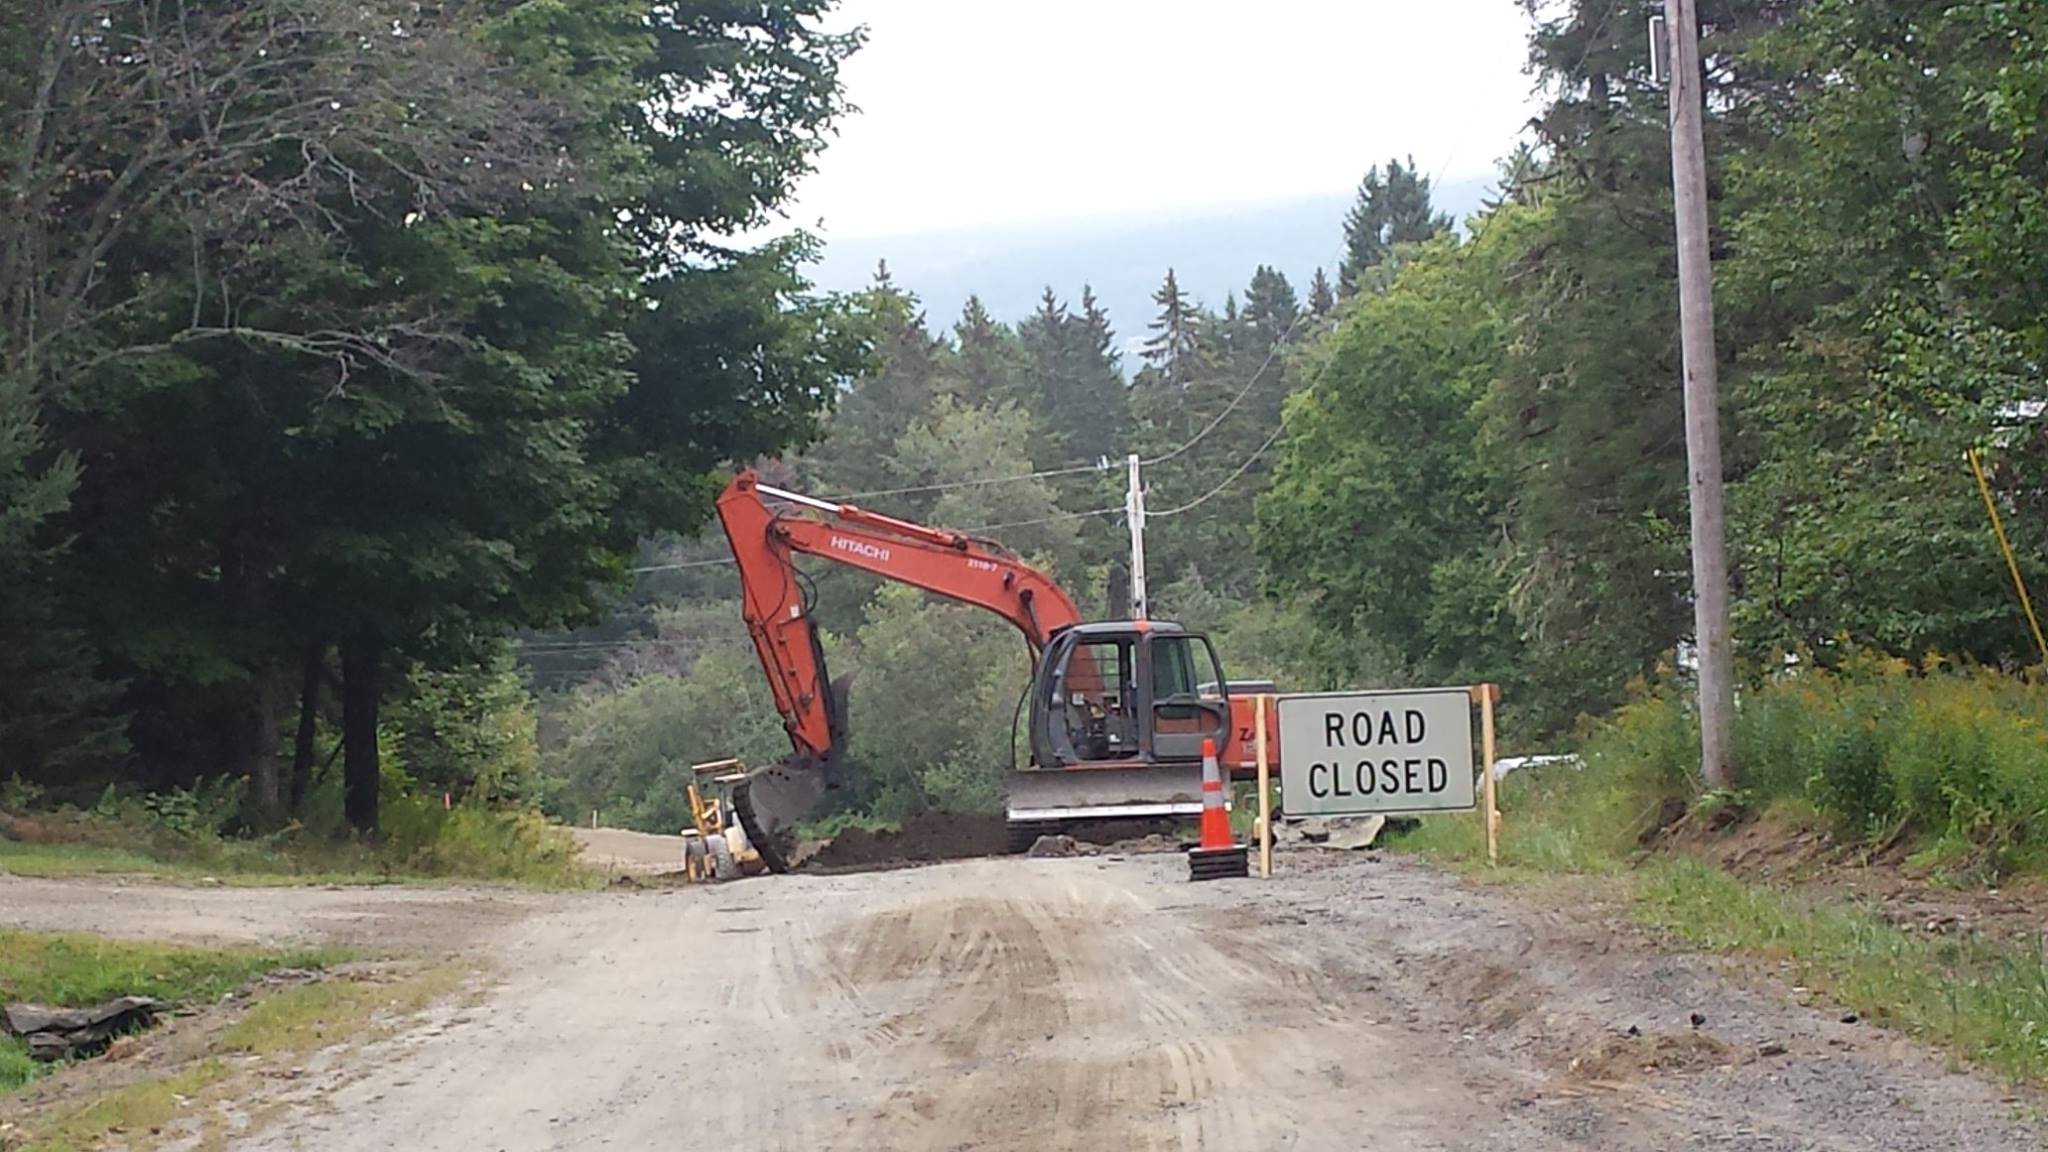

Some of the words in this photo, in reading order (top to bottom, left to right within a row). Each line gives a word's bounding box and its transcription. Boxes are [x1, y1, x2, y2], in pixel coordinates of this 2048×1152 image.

[831, 535, 890, 561] HITACHI
[1325, 710, 1425, 747] ROAD
[1309, 758, 1448, 798] CLOSED
